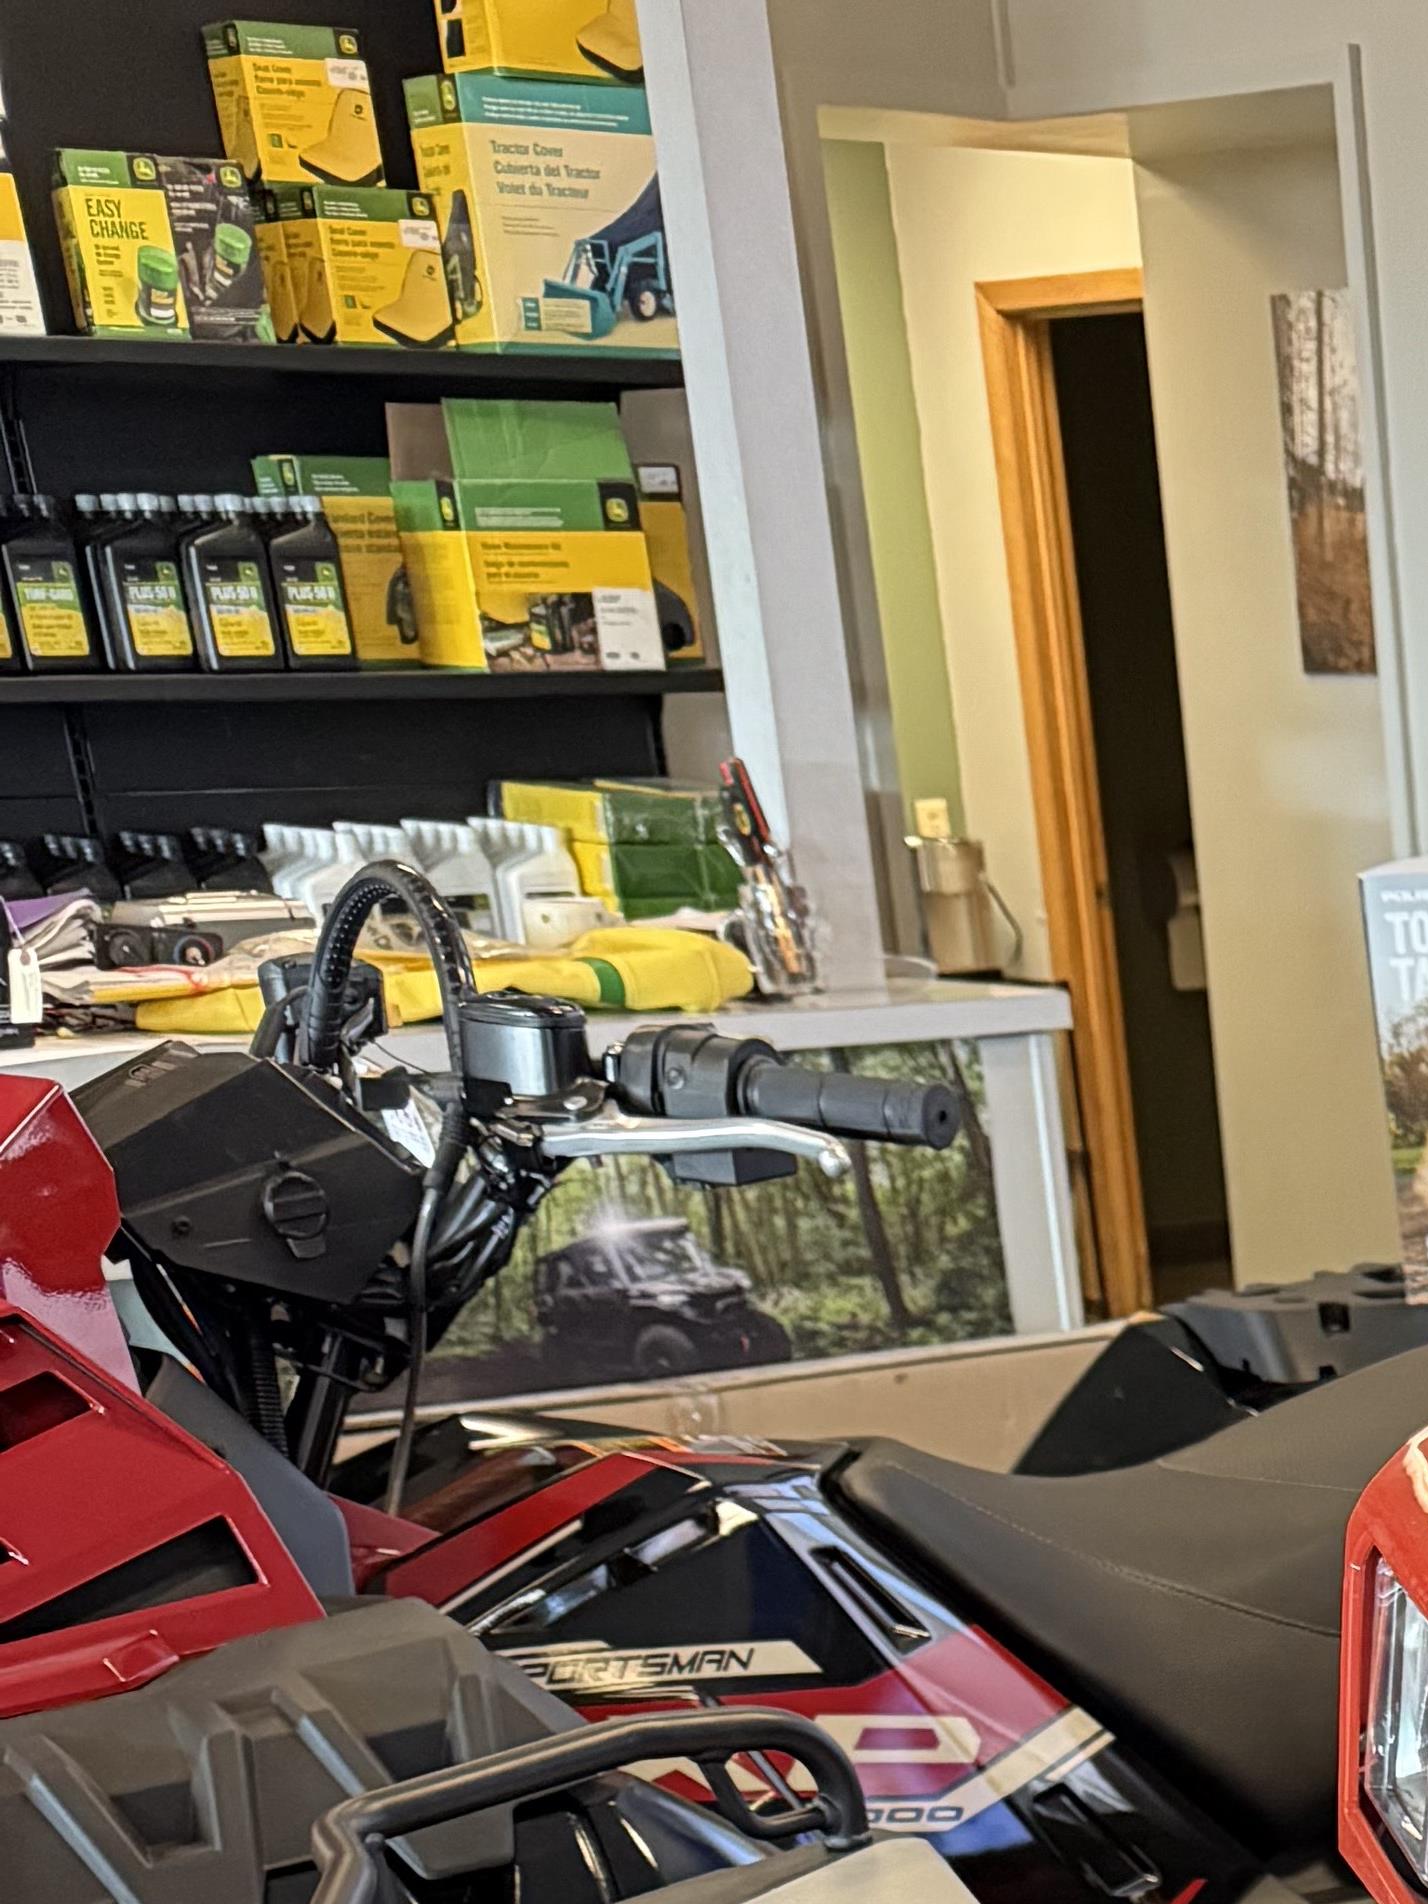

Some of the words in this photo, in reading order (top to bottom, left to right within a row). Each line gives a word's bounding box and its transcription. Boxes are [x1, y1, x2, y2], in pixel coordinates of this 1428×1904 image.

[85, 198, 121, 218] EASY
[89, 220, 148, 239] CHANGE
[521, 1646, 756, 1686] PORTSMAN
